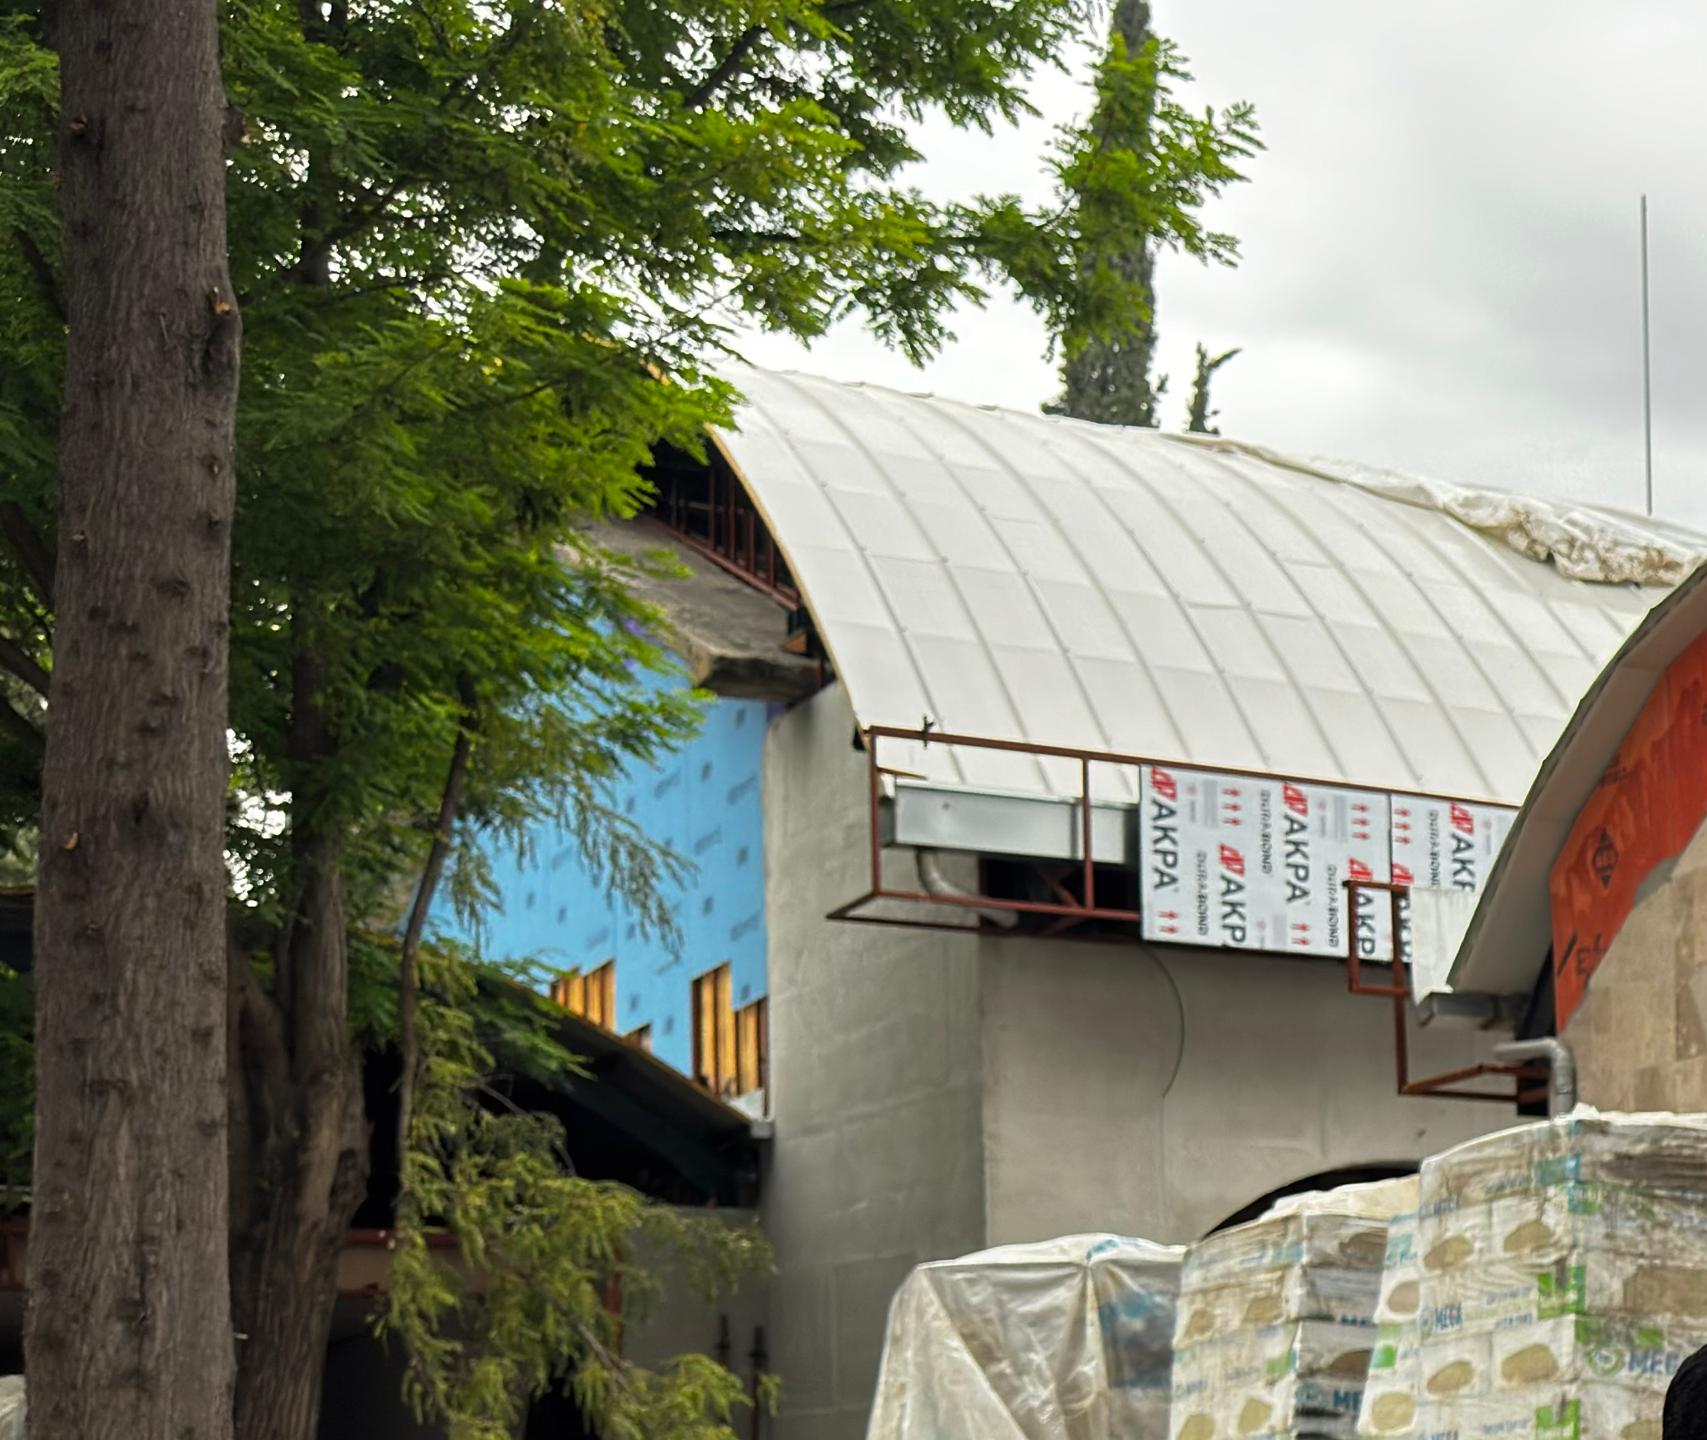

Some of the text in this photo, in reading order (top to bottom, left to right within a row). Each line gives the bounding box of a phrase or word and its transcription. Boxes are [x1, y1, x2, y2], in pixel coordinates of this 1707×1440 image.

[1152, 798, 1178, 890] AKPA
[1284, 812, 1310, 904] AKPA
[1452, 832, 1476, 893] AKP
[1220, 872, 1247, 946] AKP
[1357, 888, 1376, 956] AKP
[1434, 1304, 1463, 1331] MEGA
[1628, 1351, 1679, 1376] MEG
